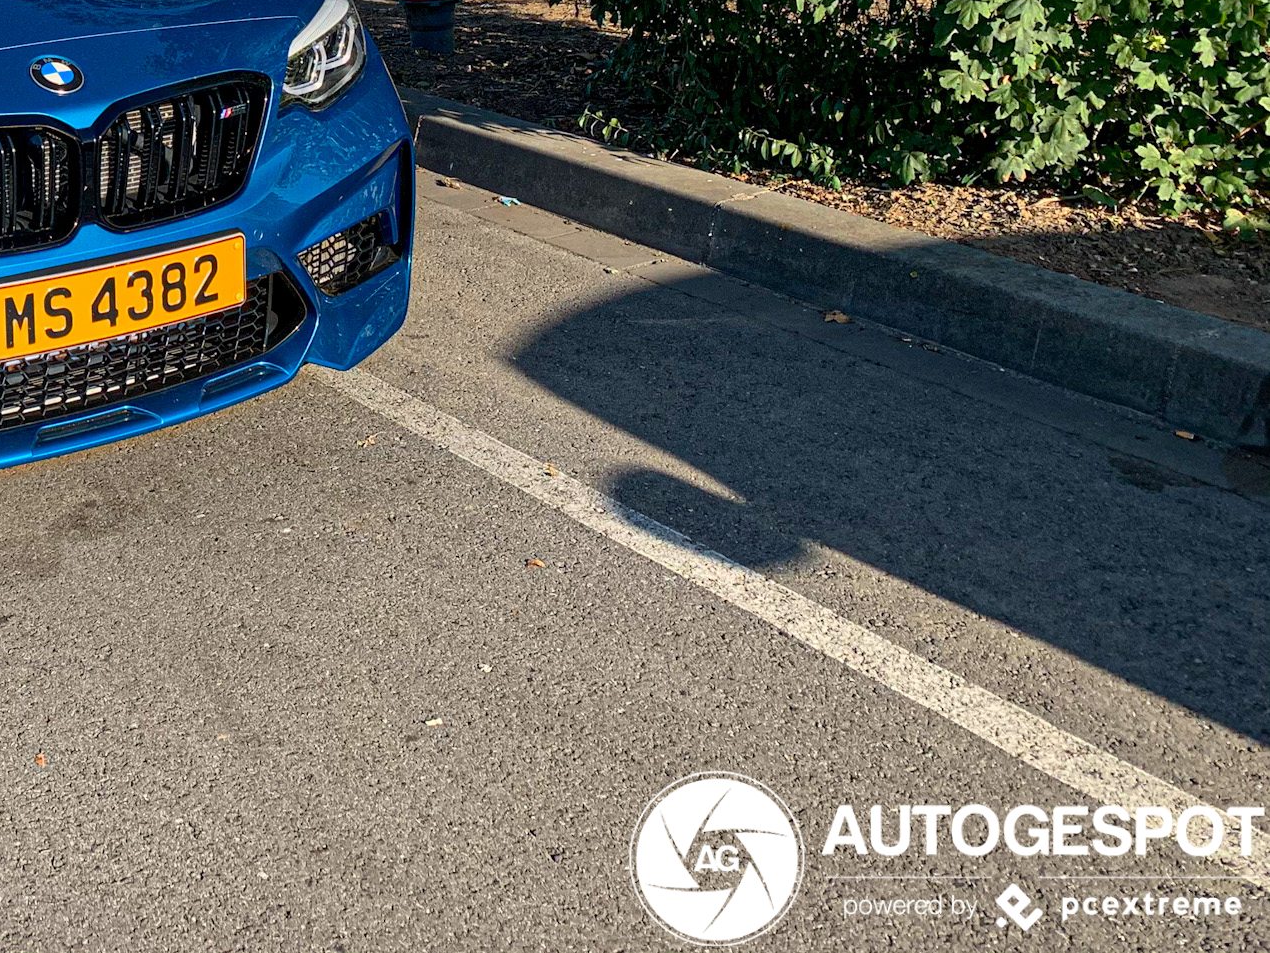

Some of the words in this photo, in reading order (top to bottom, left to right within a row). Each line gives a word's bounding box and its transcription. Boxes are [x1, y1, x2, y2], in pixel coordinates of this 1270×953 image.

[32, 57, 72, 71] BMW
[4, 287, 73, 349] MS
[91, 254, 219, 328] 4382
